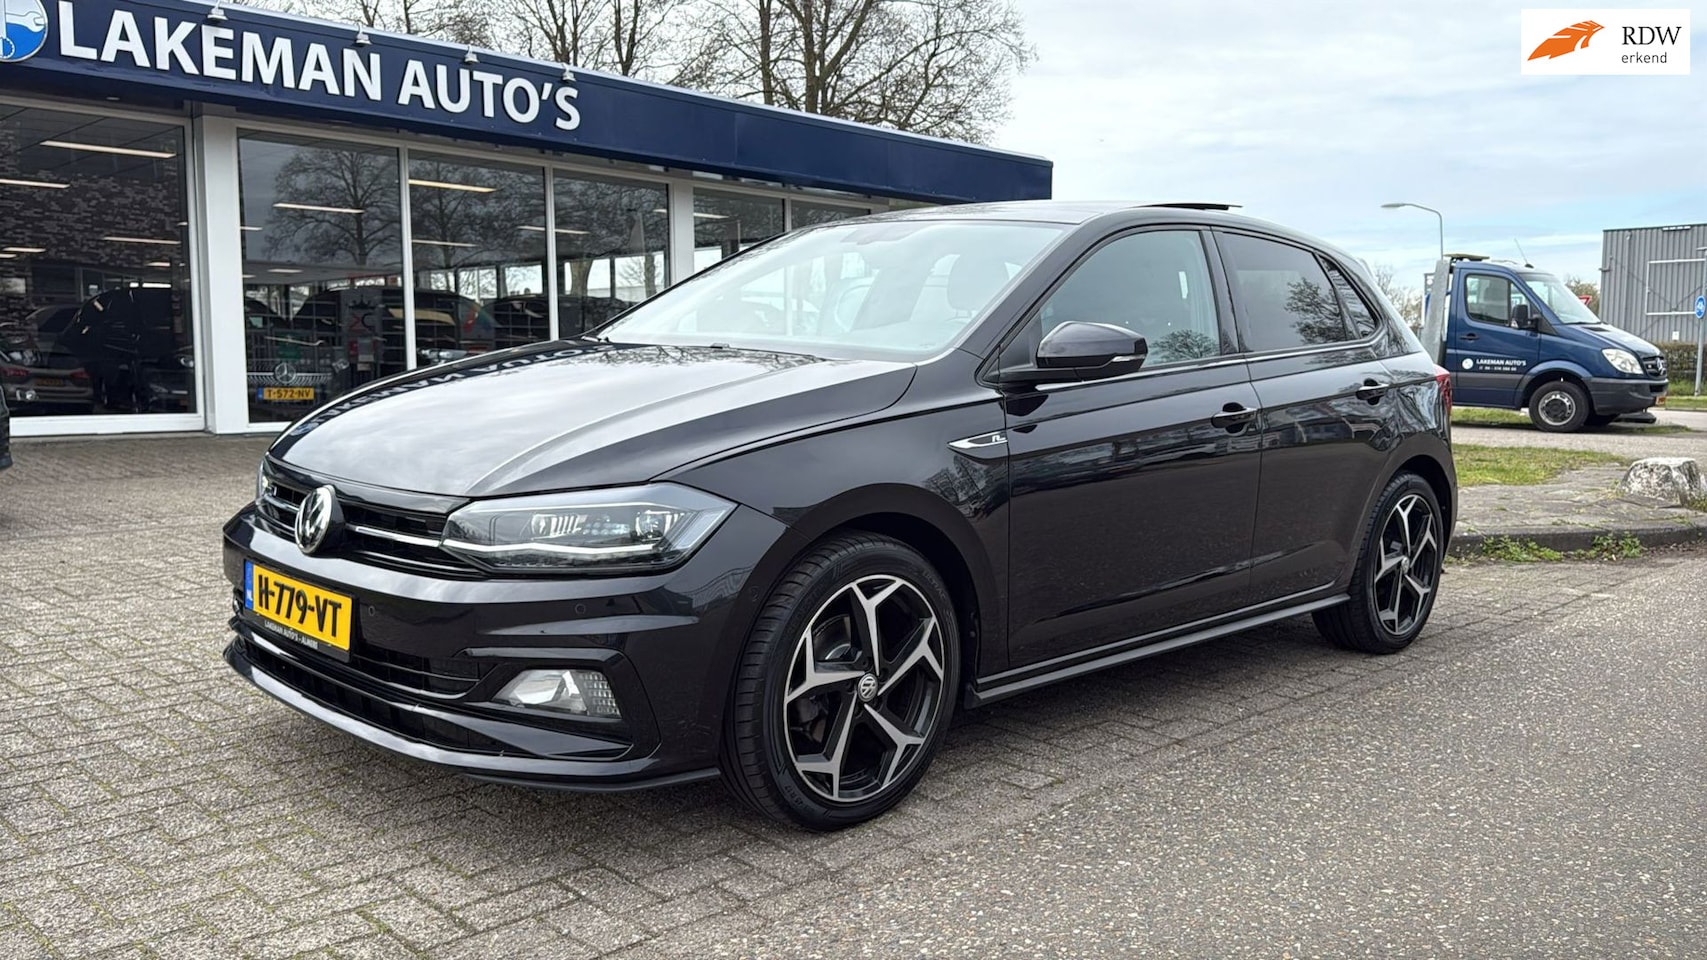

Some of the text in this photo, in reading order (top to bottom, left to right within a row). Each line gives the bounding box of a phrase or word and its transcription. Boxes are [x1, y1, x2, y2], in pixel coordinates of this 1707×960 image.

[57, 0, 581, 131] LAKEMAN AUTO'S
[1476, 358, 1504, 366] LAKEMAN
[267, 389, 311, 398] T-572-NV
[258, 574, 342, 638] H-779-VT
